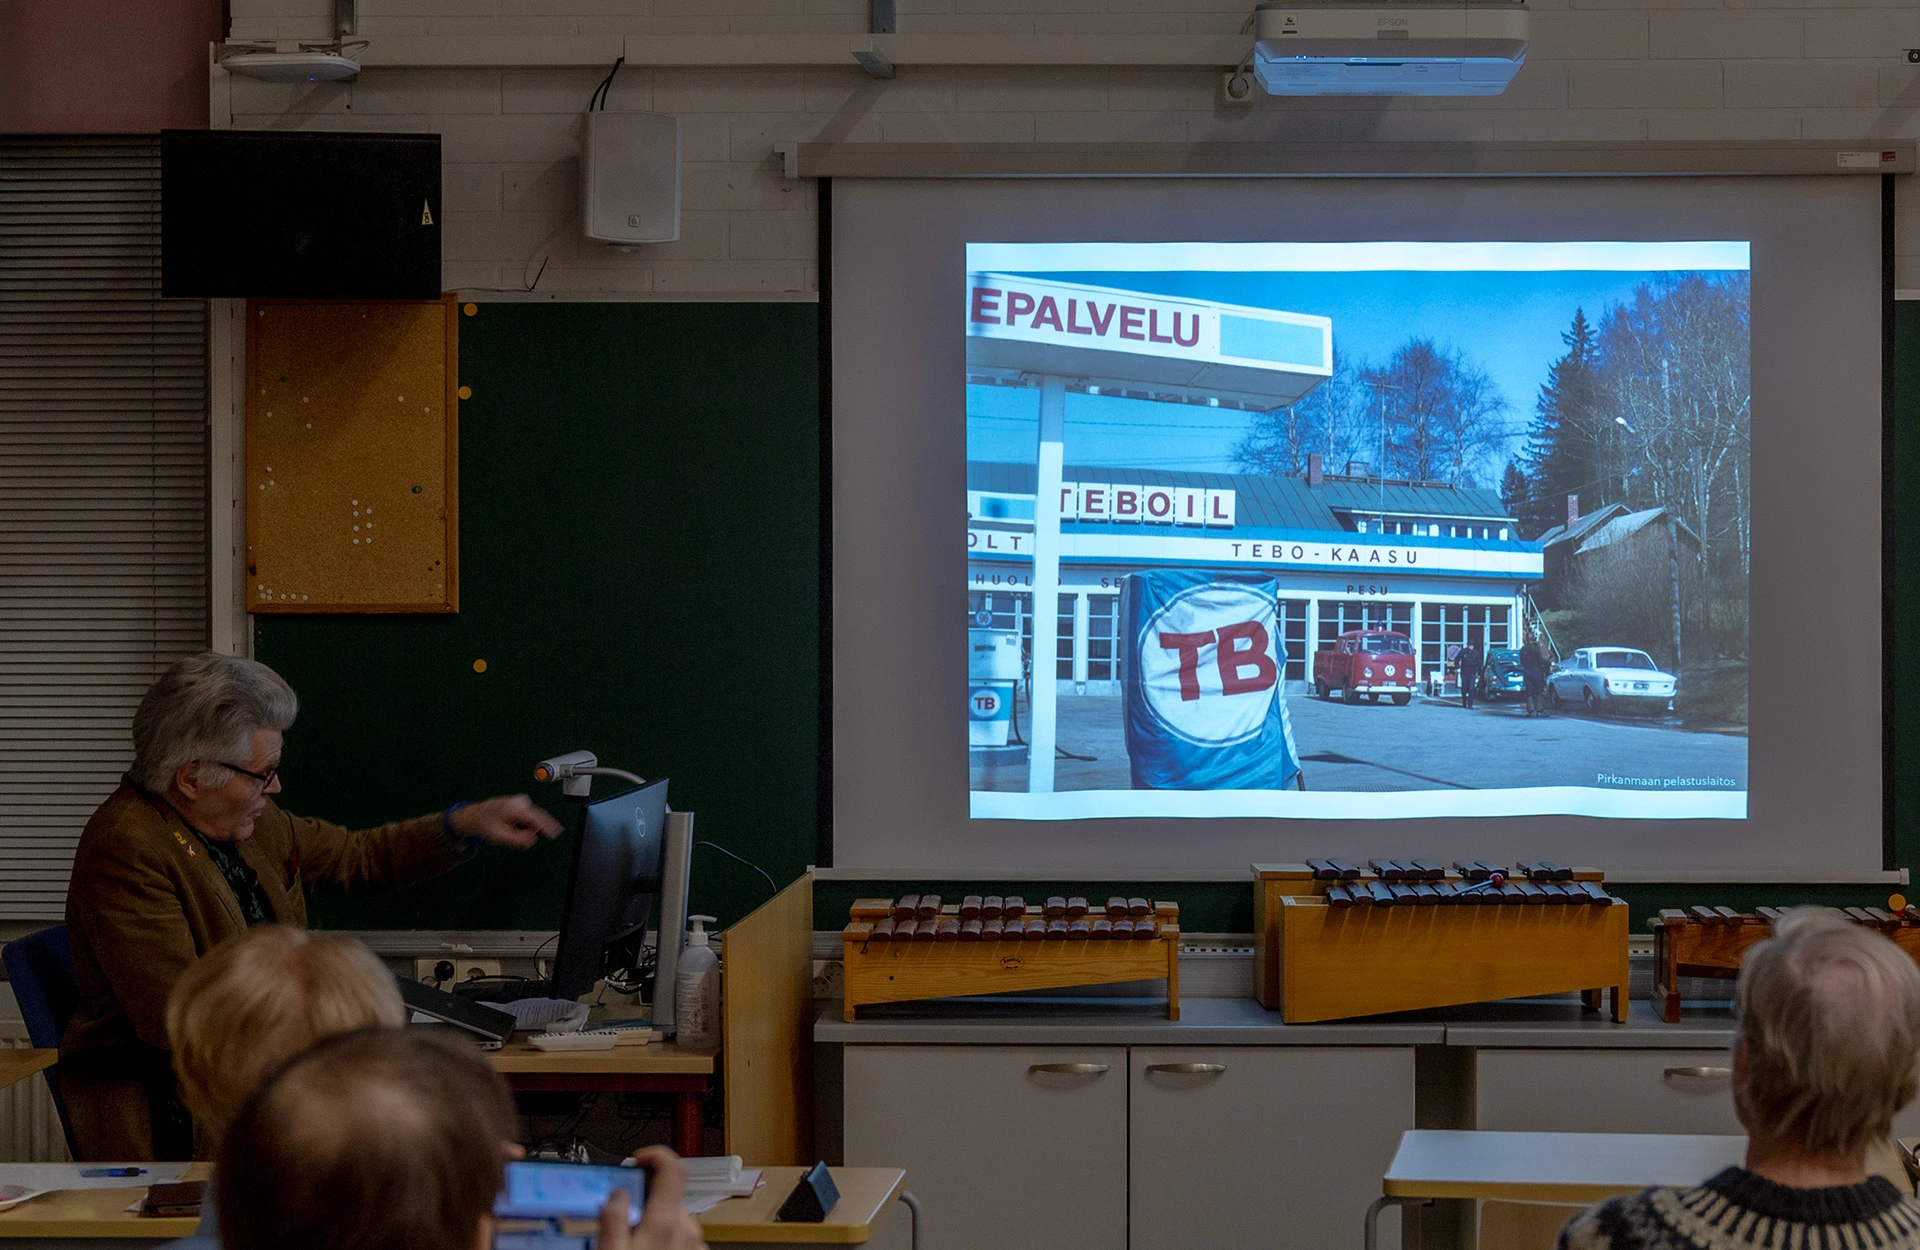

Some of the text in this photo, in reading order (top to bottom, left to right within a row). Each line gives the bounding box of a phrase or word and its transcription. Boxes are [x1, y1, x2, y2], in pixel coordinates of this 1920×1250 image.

[1378, 18, 1408, 26] EPSON
[970, 286, 1200, 347] EPALVELU
[1346, 585, 1388, 596] PESU
[1159, 620, 1277, 702] TB
[974, 697, 996, 710] TB
[1597, 773, 1736, 788] Pirkanmaan pelastuslaitos
